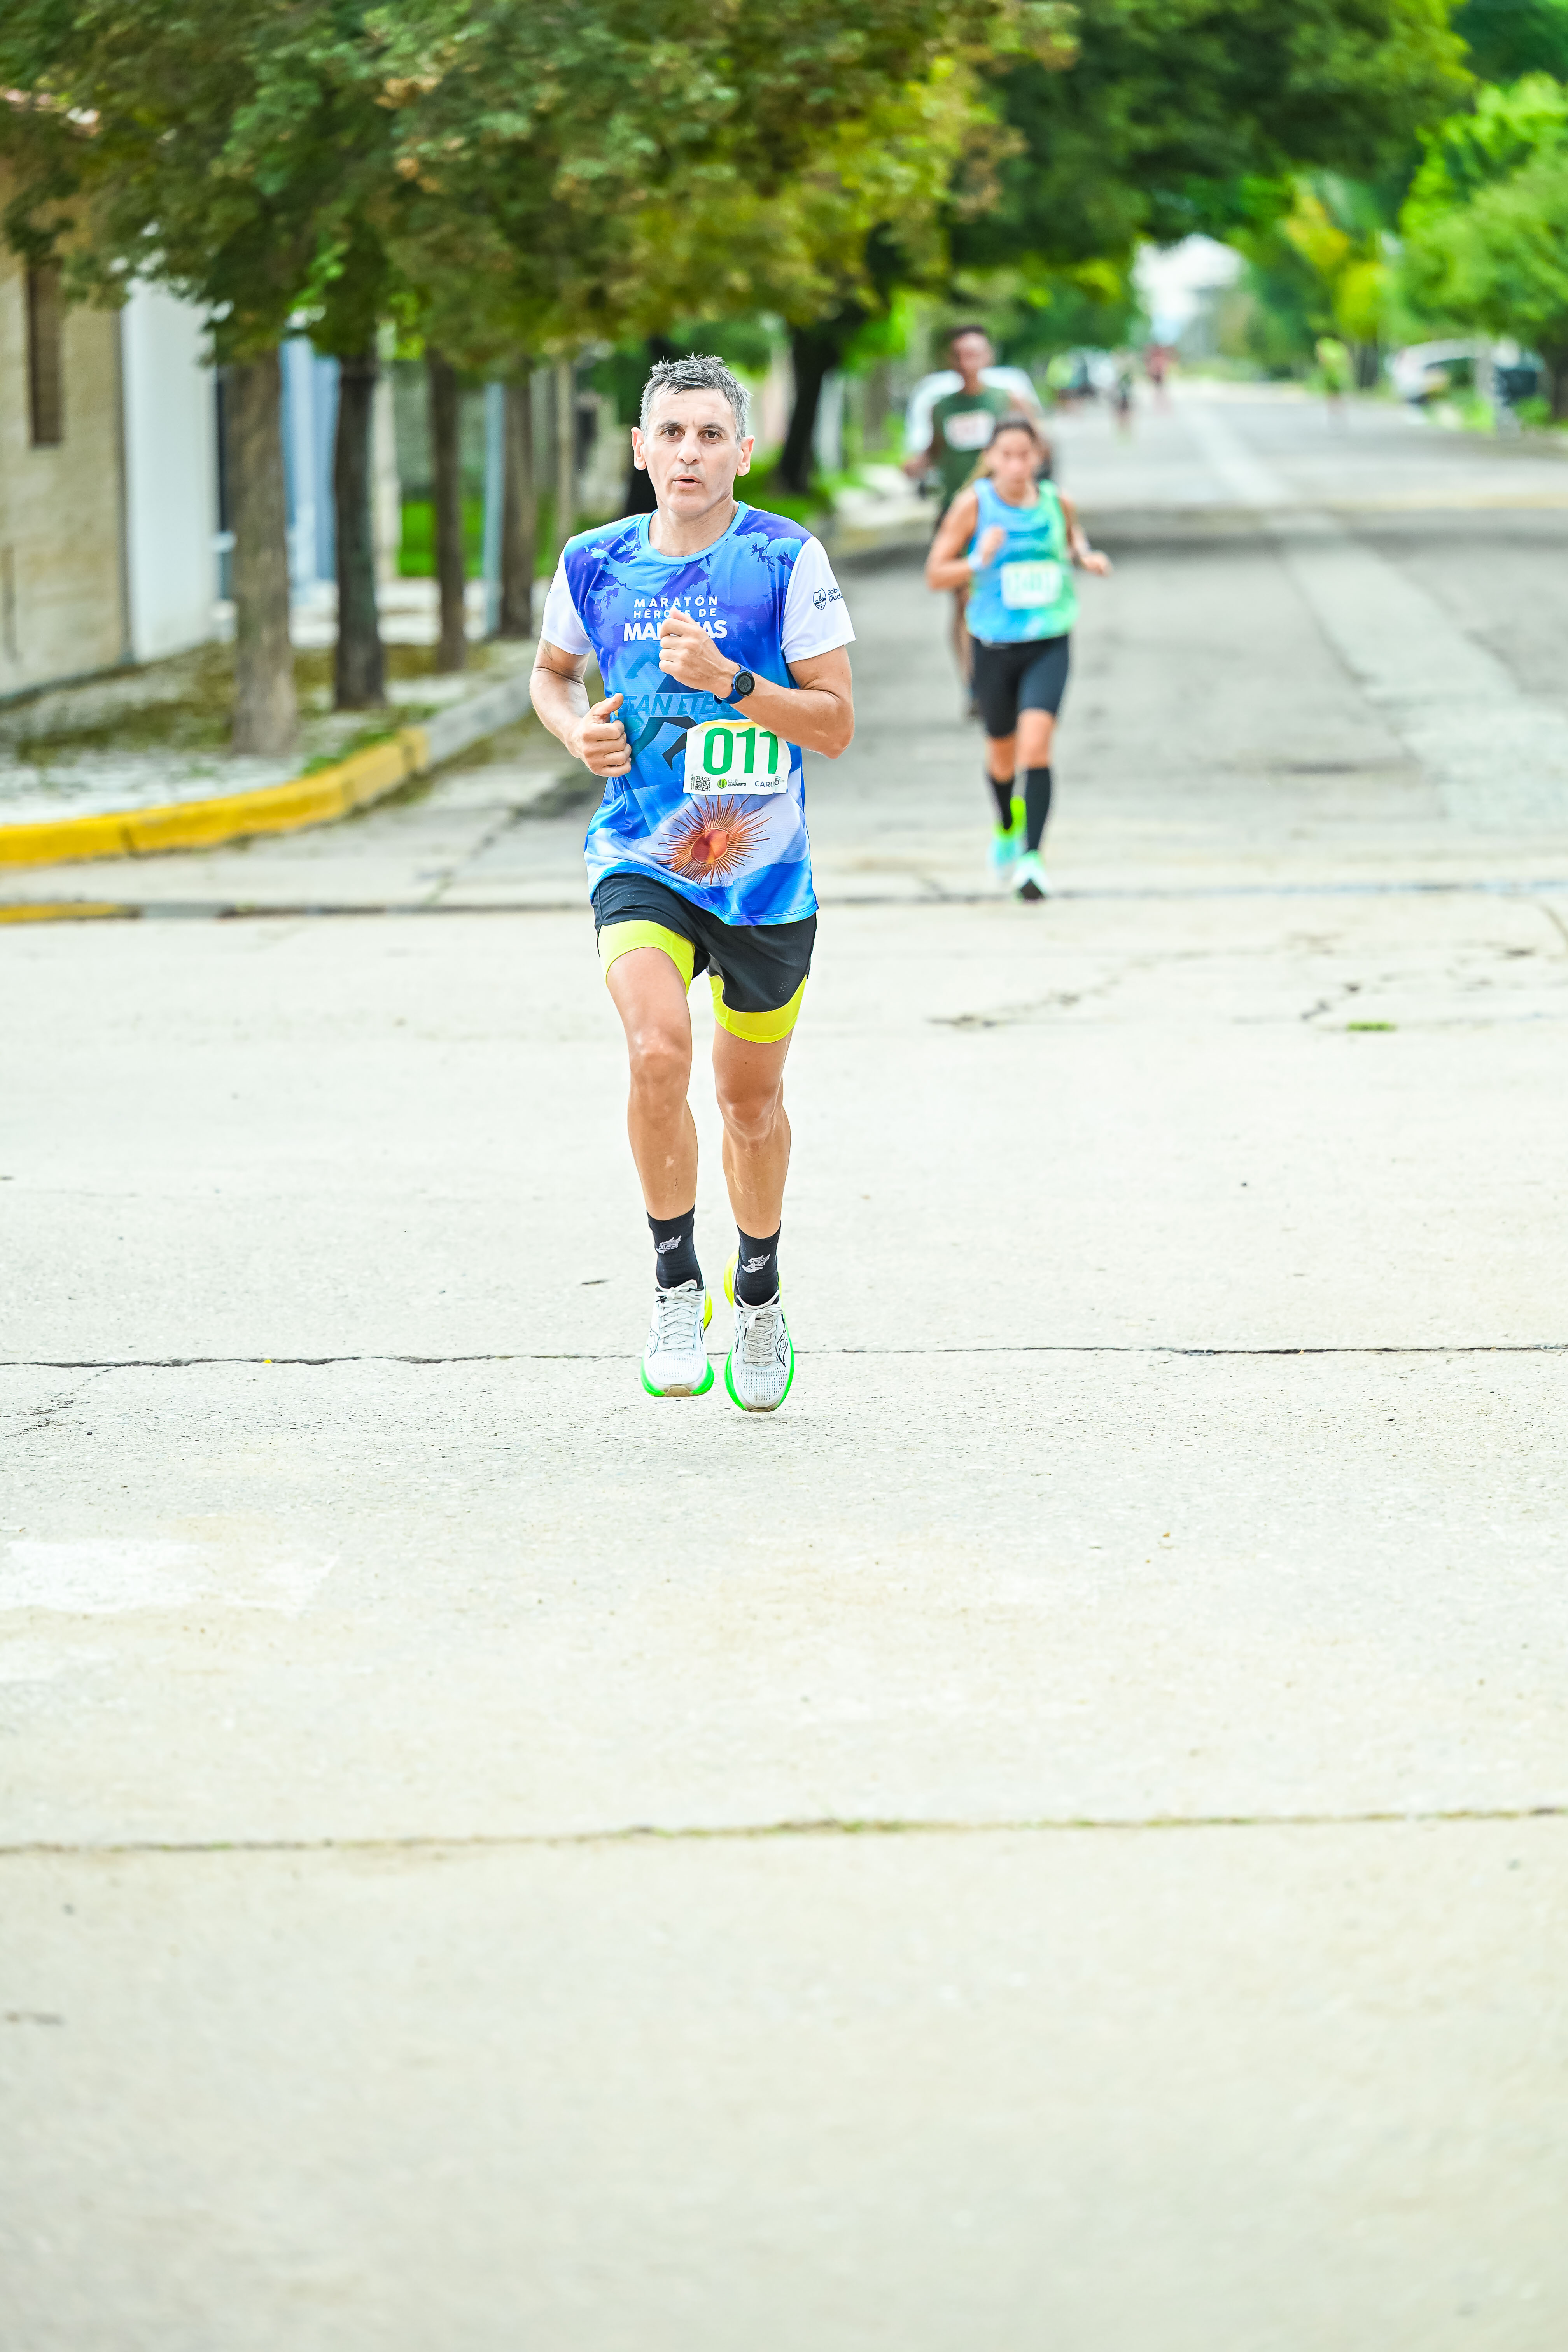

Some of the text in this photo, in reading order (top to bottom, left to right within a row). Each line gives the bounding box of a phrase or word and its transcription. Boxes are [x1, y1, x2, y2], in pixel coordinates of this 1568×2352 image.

[634, 594, 718, 608] MARATÓN
[633, 608, 716, 619] HÉROS DE
[703, 727, 778, 775] 011
